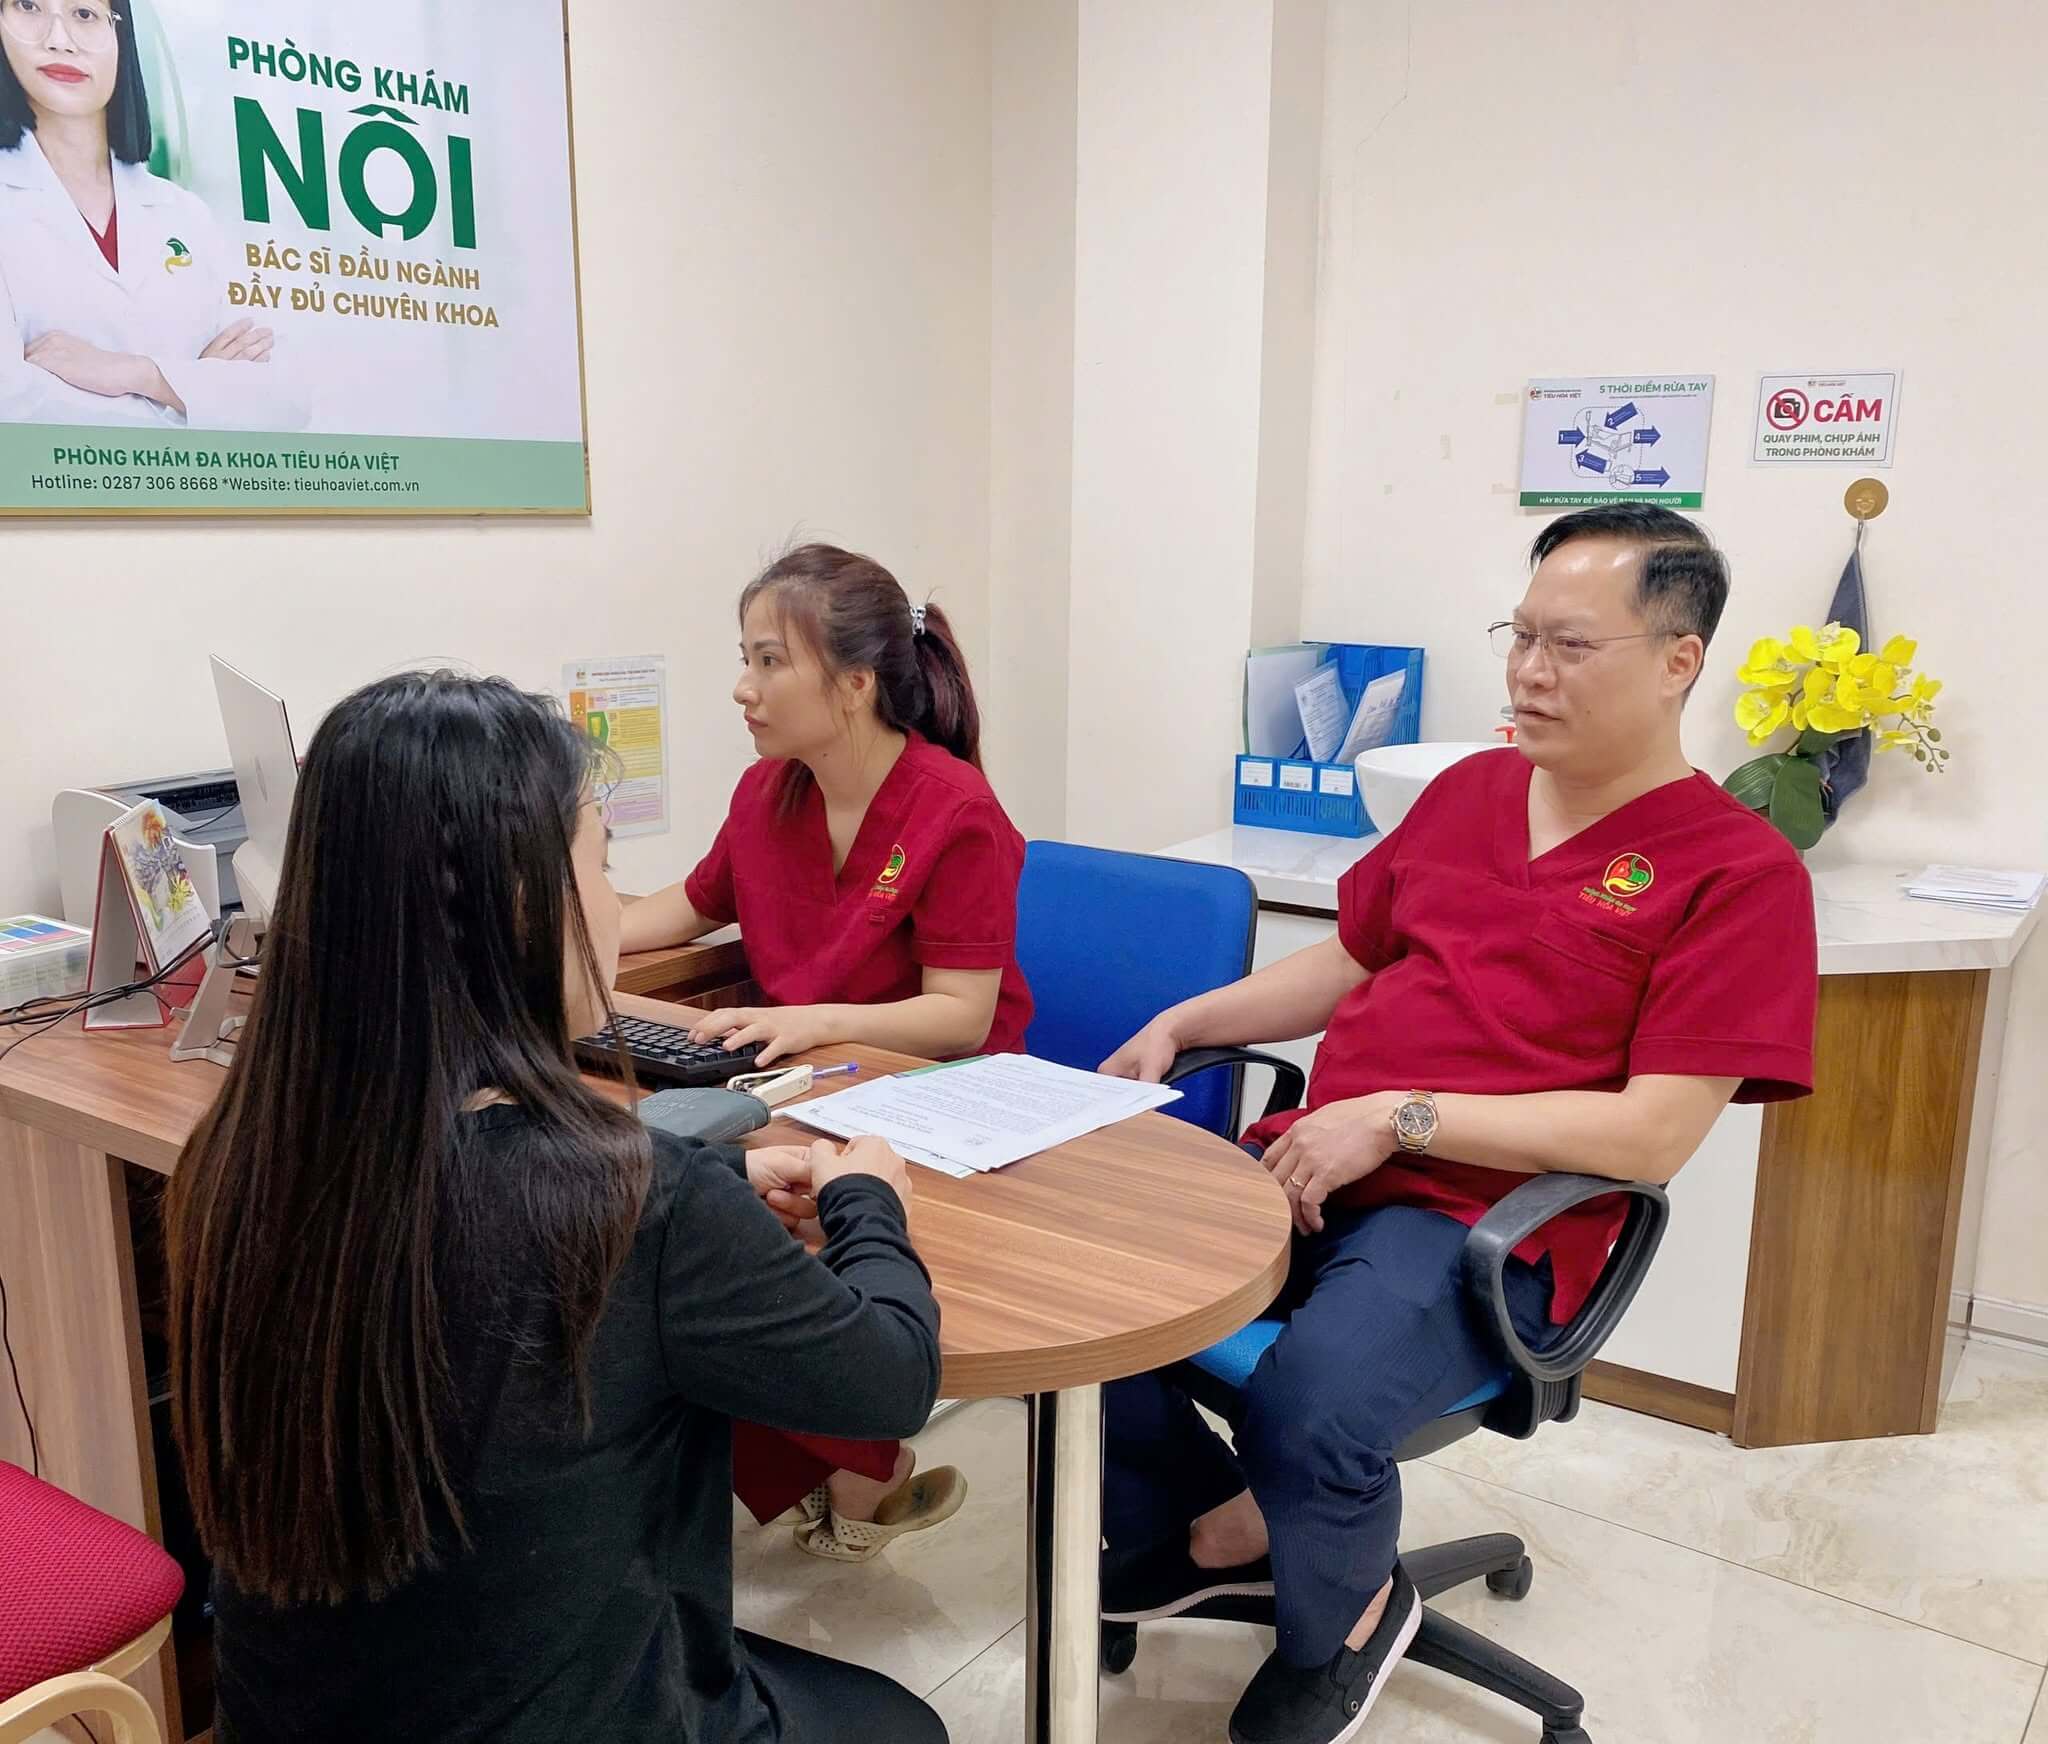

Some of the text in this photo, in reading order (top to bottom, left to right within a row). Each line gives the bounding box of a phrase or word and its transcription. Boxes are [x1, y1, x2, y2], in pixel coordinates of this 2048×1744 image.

[227, 36, 469, 115] PHÒNG KHÁM
[245, 239, 480, 290] BÁC SĨ ĐẦU NGÀNH
[228, 272, 499, 328] ĐẦY ĐỦ CHUYÊN KHOA
[1599, 385, 1605, 393] 5
[1687, 383, 1708, 391] TAY
[1813, 393, 1883, 422] CẤM
[1763, 434, 1792, 443] QUAY
[1793, 434, 1822, 444] PHIM,
[1824, 434, 1855, 445] CHỤP
[53, 445, 399, 473] PHÒNG KHÁM ĐA KHOA TIÊU HÓA VIỆT
[1766, 448, 1801, 456] TRONG
[31, 474, 98, 489] Hotline:
[102, 476, 141, 490] 0287
[146, 476, 175, 490] 306
[179, 477, 218, 490] 8668
[294, 478, 419, 491] tieuhoaviet.com.vn
[1636, 473, 1642, 481] 5
